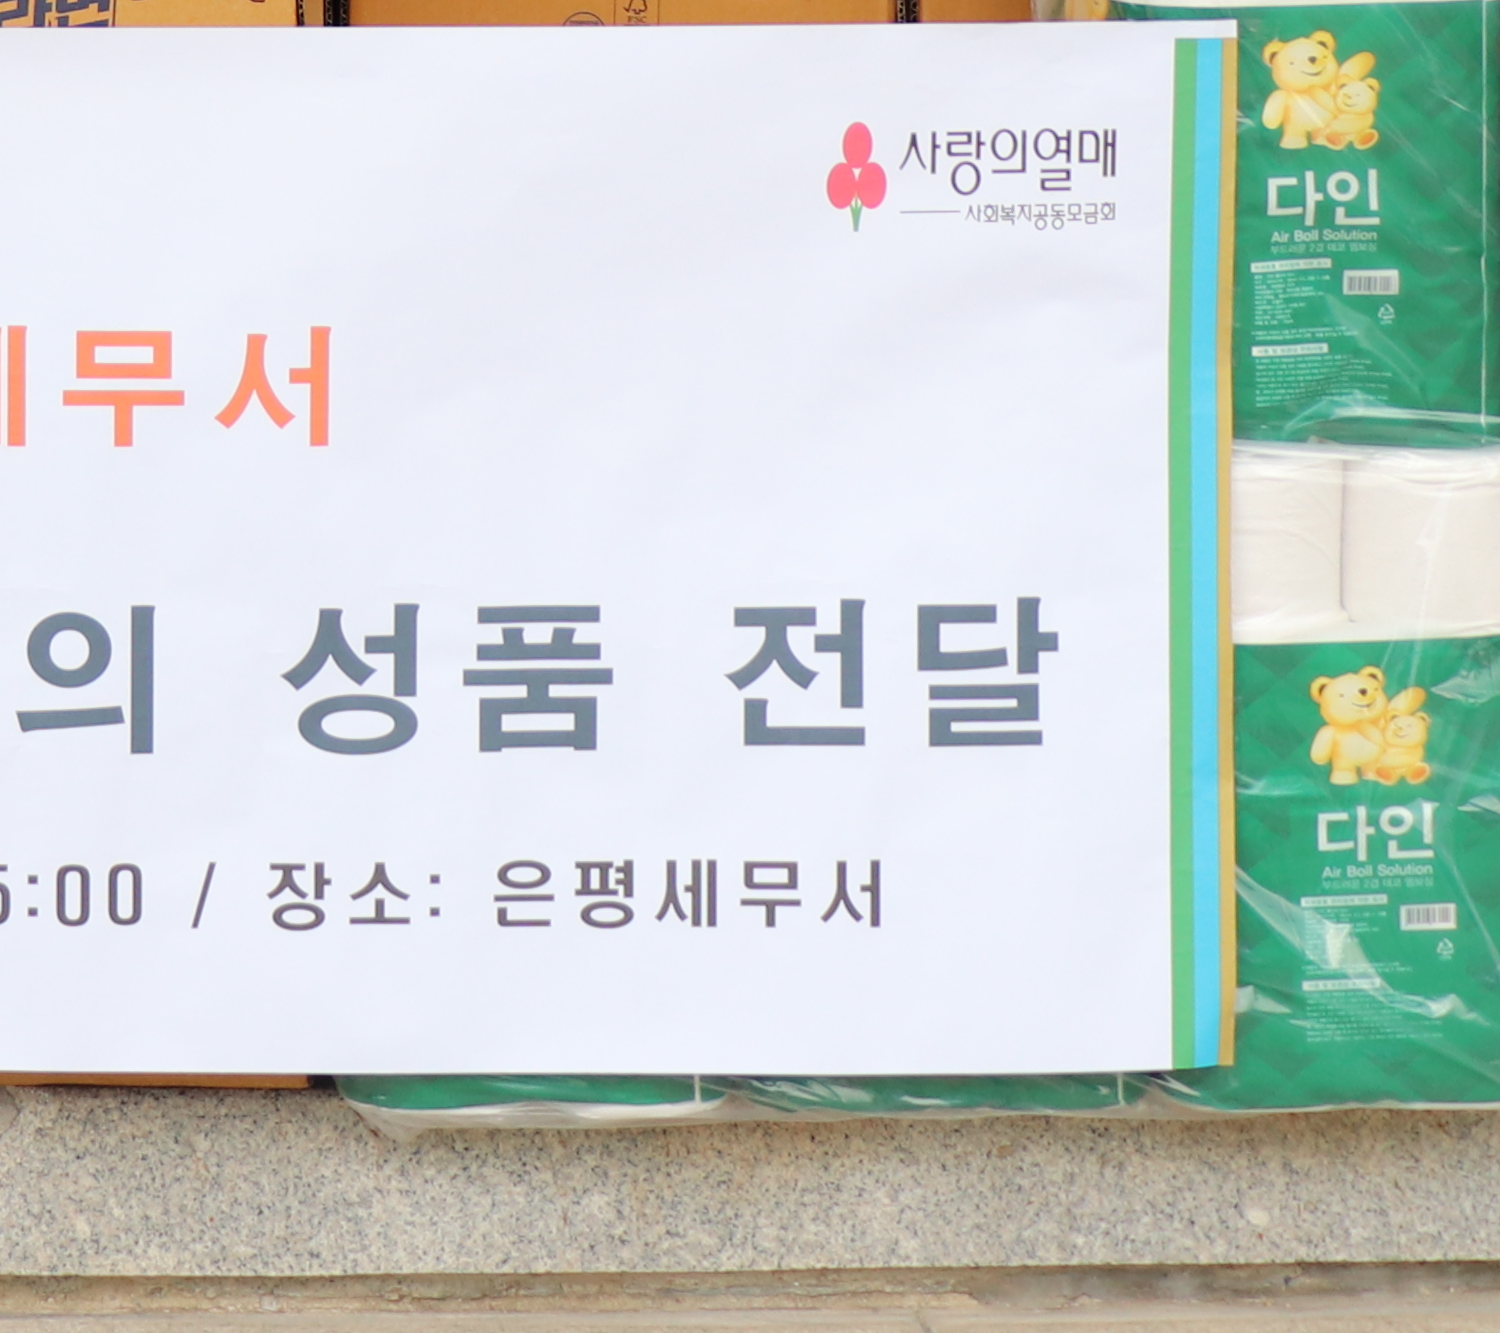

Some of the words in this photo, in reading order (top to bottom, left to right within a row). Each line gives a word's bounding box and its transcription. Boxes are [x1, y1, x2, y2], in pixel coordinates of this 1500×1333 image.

[899, 128, 1117, 196] 사랑의열매
[964, 202, 1117, 231] 사회복지공동모금회
[1266, 168, 1381, 226] 다인
[280, 602, 614, 756] 성품
[724, 596, 1059, 748] 전달
[1317, 802, 1436, 862] 다인
[191, 861, 216, 929] /
[266, 861, 441, 932] 장소:
[493, 858, 881, 930] 은평세무서
